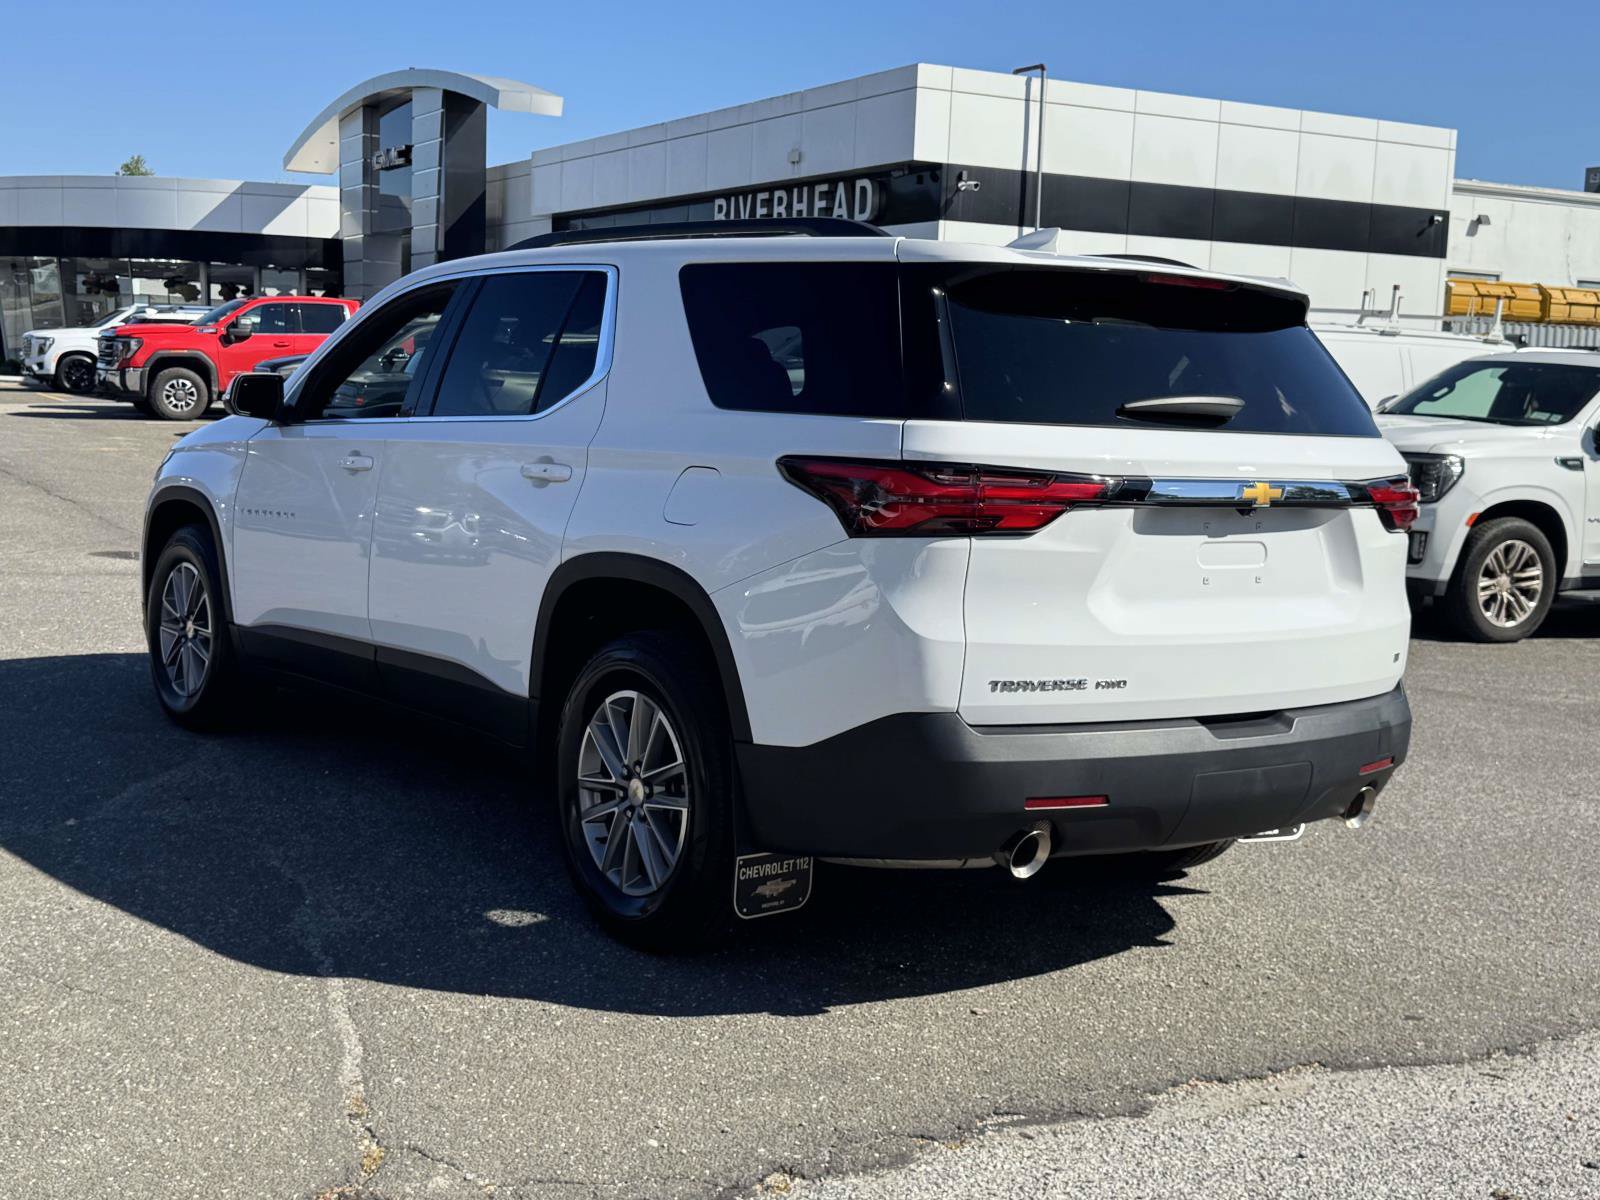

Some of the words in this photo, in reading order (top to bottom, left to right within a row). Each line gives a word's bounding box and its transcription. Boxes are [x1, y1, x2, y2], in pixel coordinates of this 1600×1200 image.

[713, 178, 875, 222] RIVERHEAD
[988, 679, 1087, 693] TRAVERSE
[739, 859, 795, 880] CHEVROLET
[795, 856, 809, 871] 112
